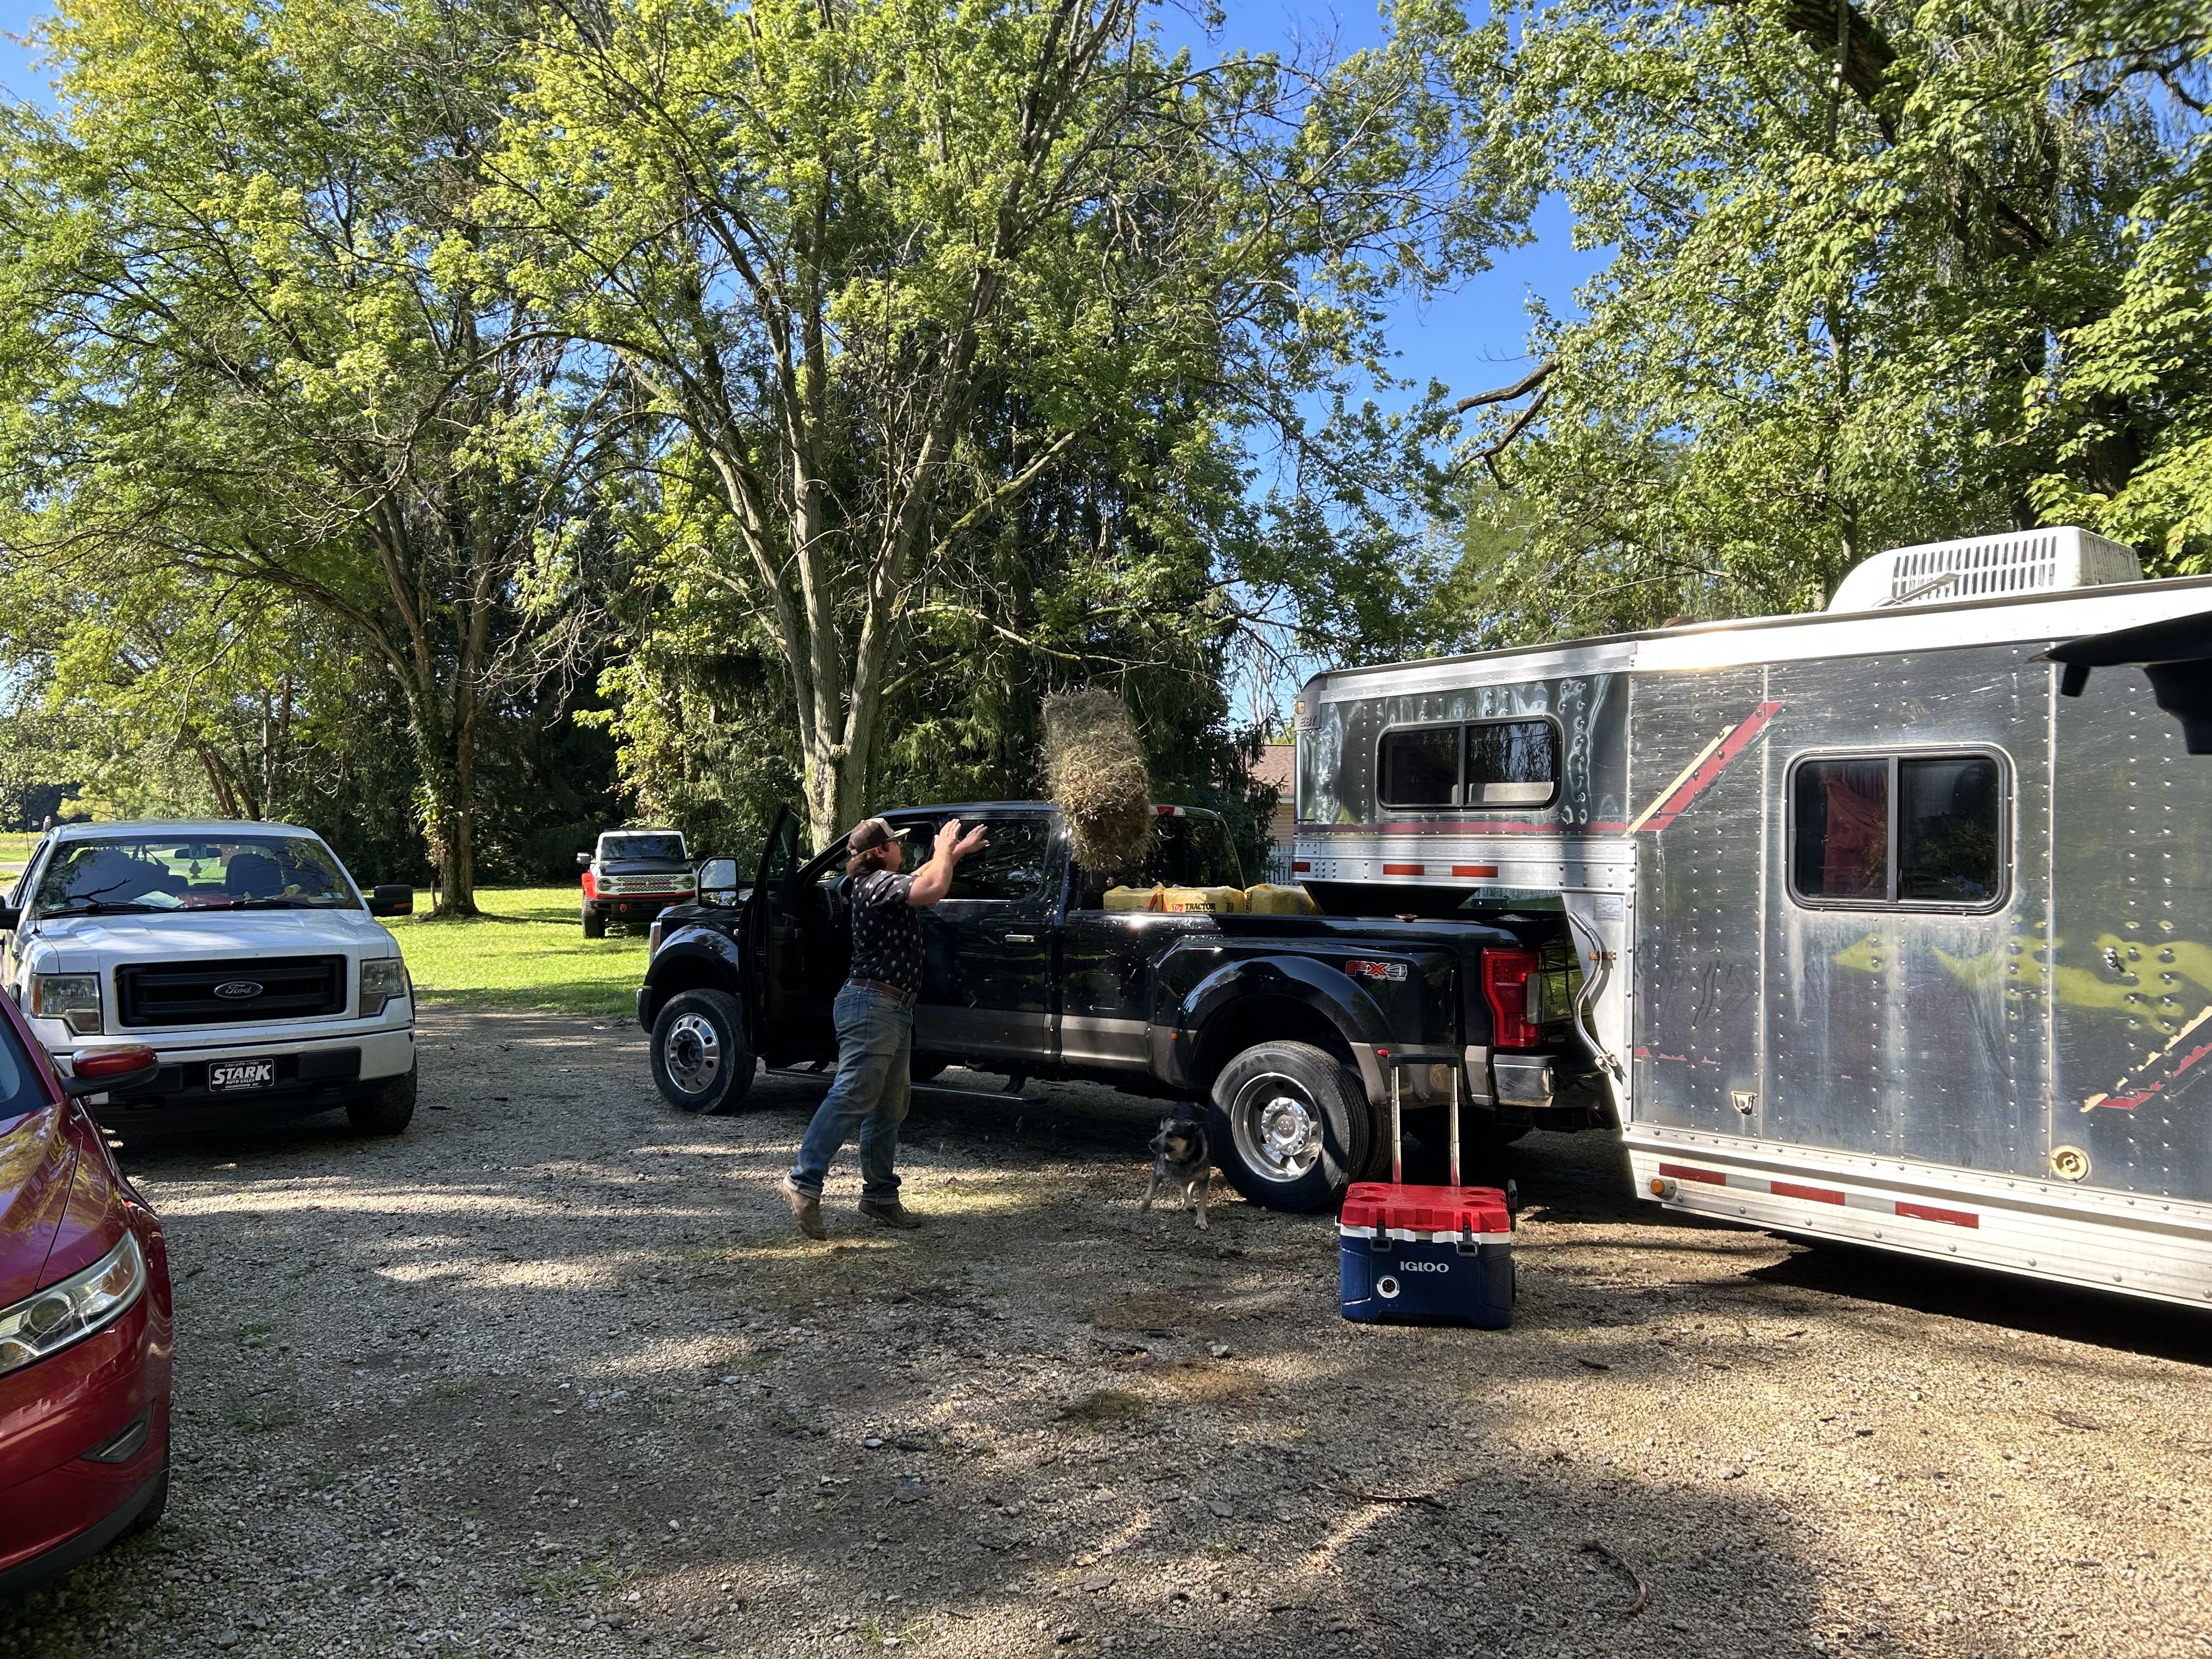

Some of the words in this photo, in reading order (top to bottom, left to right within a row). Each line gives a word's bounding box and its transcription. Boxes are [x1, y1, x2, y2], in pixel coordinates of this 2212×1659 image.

[1300, 715, 1318, 727] EBY
[1345, 961, 1407, 977] FX4
[225, 984, 252, 994] Ford
[212, 1065, 272, 1084] STARK
[1400, 1261, 1449, 1273] IGLOO
